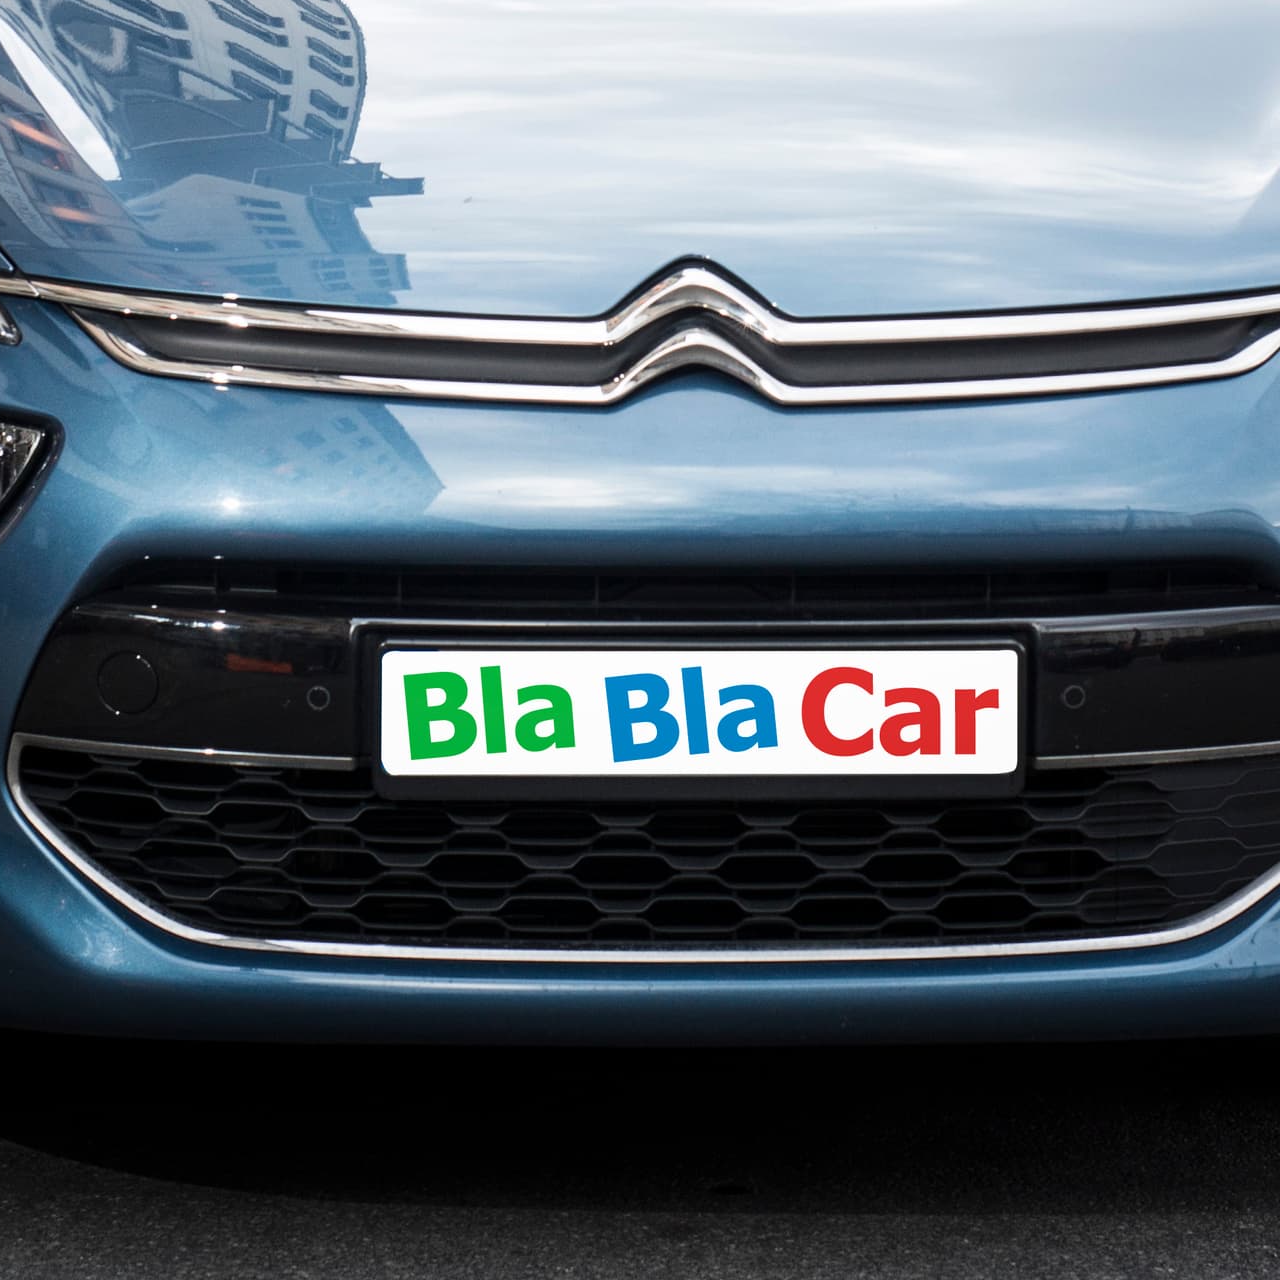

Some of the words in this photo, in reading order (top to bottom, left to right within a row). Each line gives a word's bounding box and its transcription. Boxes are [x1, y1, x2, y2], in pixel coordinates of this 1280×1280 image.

[403, 665, 576, 761] Bla
[604, 665, 778, 763] Bla
[801, 666, 999, 757] Car
